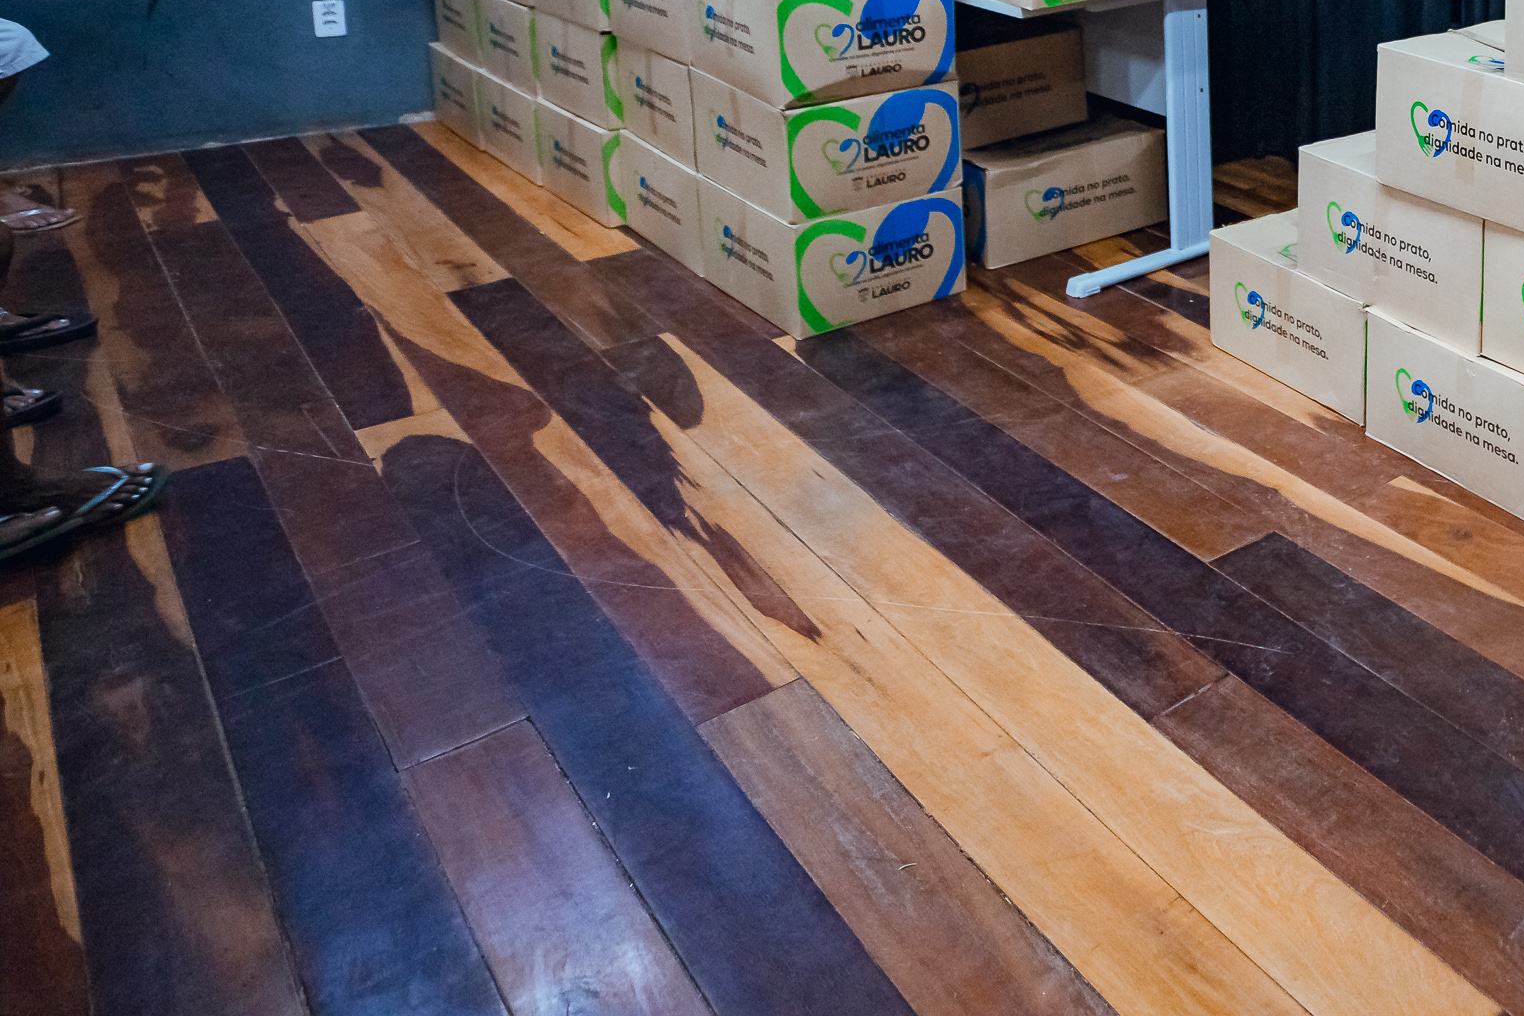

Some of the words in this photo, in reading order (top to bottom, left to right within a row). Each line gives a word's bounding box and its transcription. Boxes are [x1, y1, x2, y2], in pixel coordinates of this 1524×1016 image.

[855, 13, 921, 33] alimenta
[857, 26, 926, 51] LAURO
[861, 63, 902, 78] LAURO
[862, 123, 926, 146] alimenta
[1431, 114, 1476, 139] Comida
[1478, 130, 1495, 144] no
[863, 134, 930, 163] LAURO
[1423, 132, 1484, 163] dignidade
[1485, 154, 1502, 169] na
[866, 172, 906, 189] LAURO
[1086, 181, 1100, 192] no
[1093, 194, 1106, 204] na
[868, 232, 930, 257] alimenta
[1343, 214, 1382, 241] Comida
[1383, 233, 1398, 247] no
[1399, 239, 1432, 264] prato,
[869, 243, 934, 275] LAURO
[1337, 231, 1388, 263] dignidade
[1389, 255, 1403, 270] na
[1405, 262, 1438, 286] mesa.
[872, 280, 911, 300] LAURO
[1249, 293, 1283, 319] Comida
[1283, 312, 1295, 325] no
[1296, 318, 1323, 341] prato,
[1244, 308, 1288, 339] dignidade
[1289, 332, 1301, 346] na
[1302, 339, 1329, 361] mesa.
[1414, 384, 1456, 414] Comida
[1458, 407, 1473, 422] no
[1475, 415, 1511, 443] prato,
[1407, 400, 1464, 437] dignidade
[1465, 430, 1480, 447] na
[1482, 439, 1519, 466] mesa.
